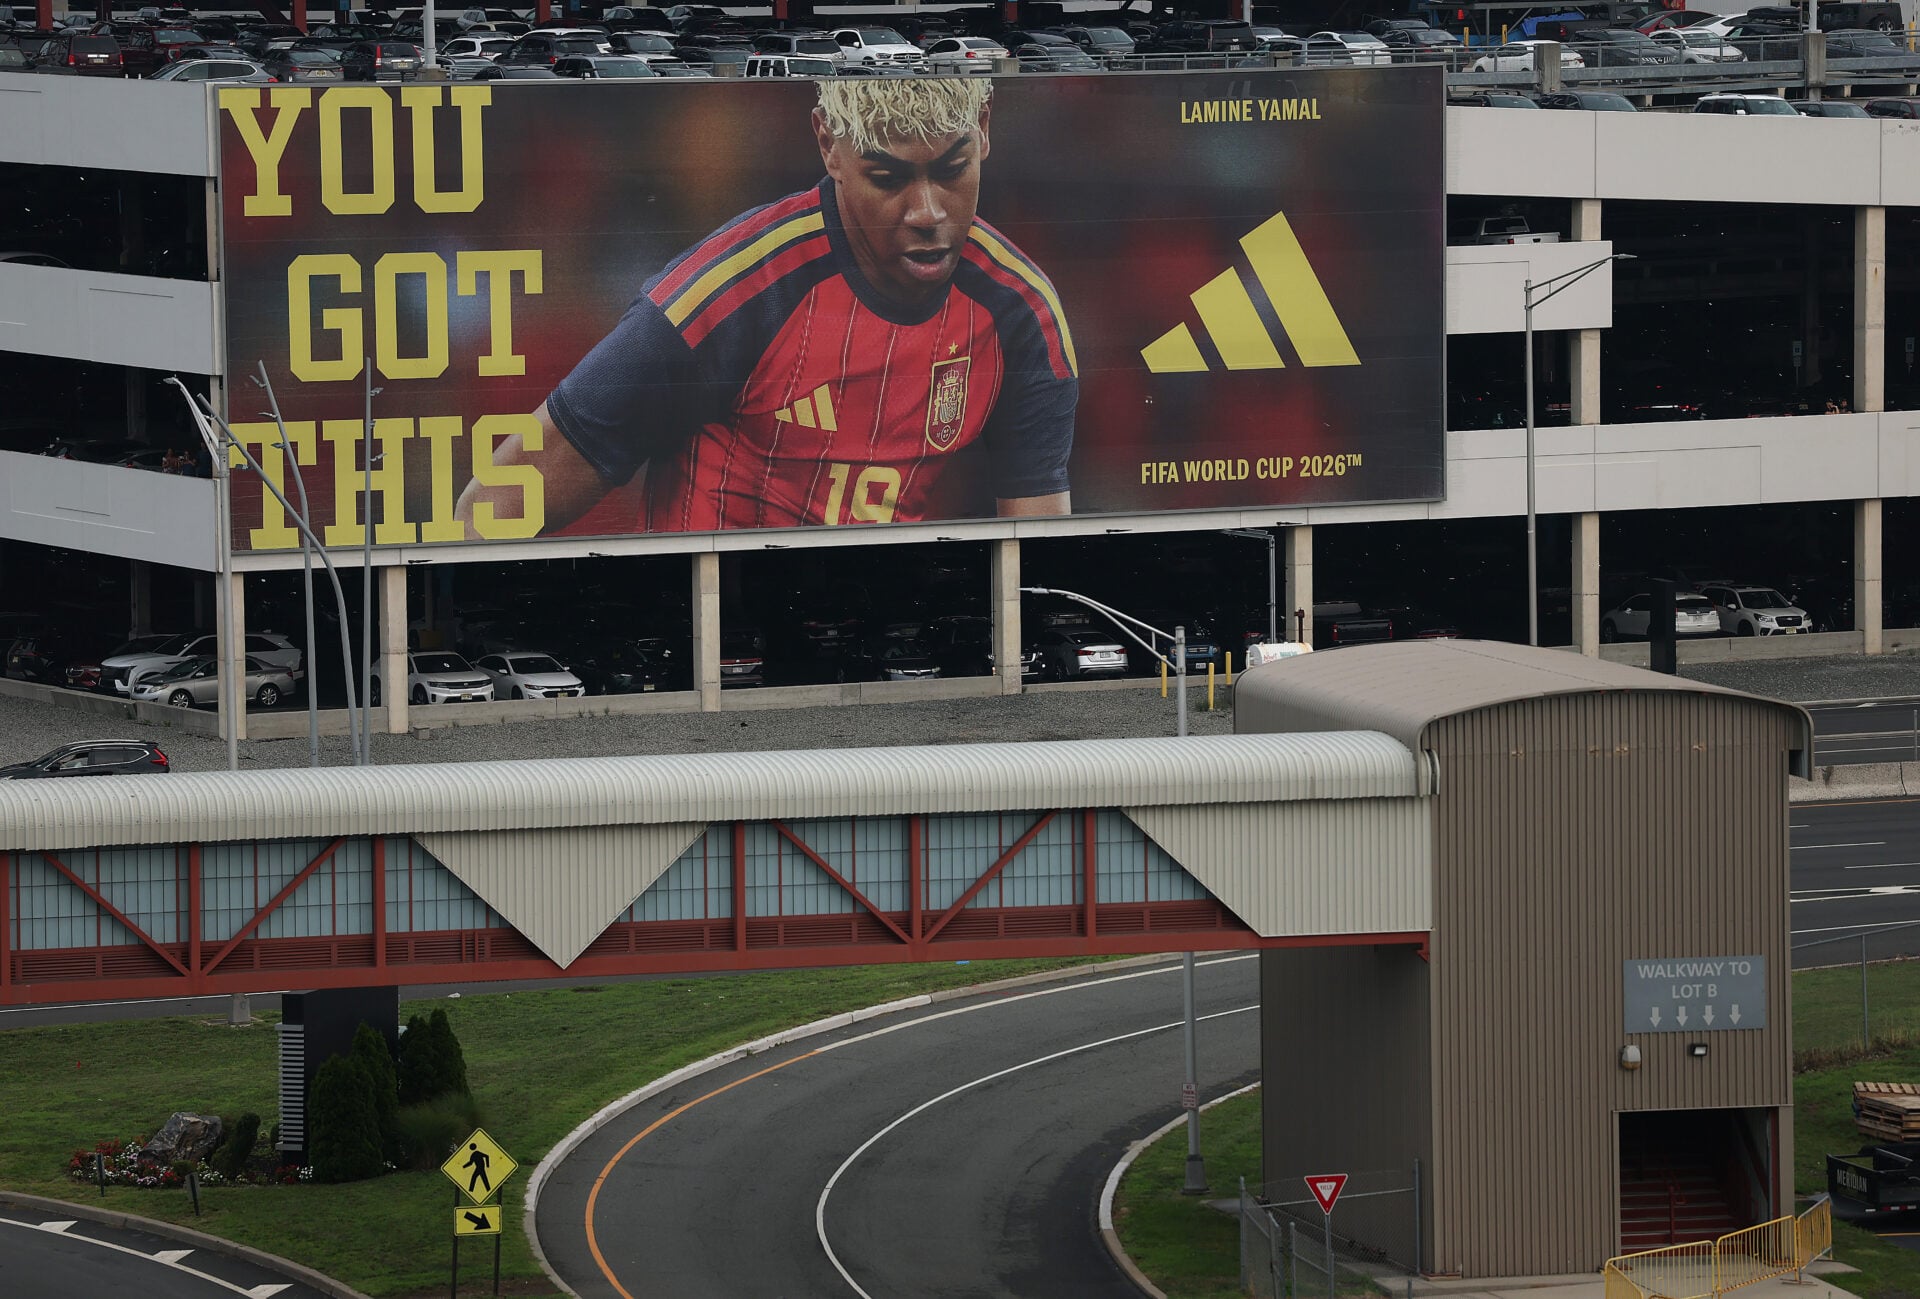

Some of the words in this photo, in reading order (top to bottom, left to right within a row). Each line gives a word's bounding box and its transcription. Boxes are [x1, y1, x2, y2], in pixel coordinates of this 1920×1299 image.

[1181, 100, 1253, 124] LAMINE
[1258, 98, 1322, 121] YAMAL
[219, 86, 492, 217] YOU
[287, 249, 543, 382] GOT
[229, 414, 545, 550] THIS
[1141, 461, 1179, 484] FIFA
[1184, 459, 1249, 482] WORLD
[1256, 457, 1293, 479] CUP
[824, 463, 901, 525] 19
[1638, 962, 1724, 979] WALKWAY
[1728, 961, 1751, 976] TO
[1672, 984, 1702, 999] LOT
[1708, 983, 1718, 998] B
[1836, 1169, 1867, 1193] MERIDIAN
